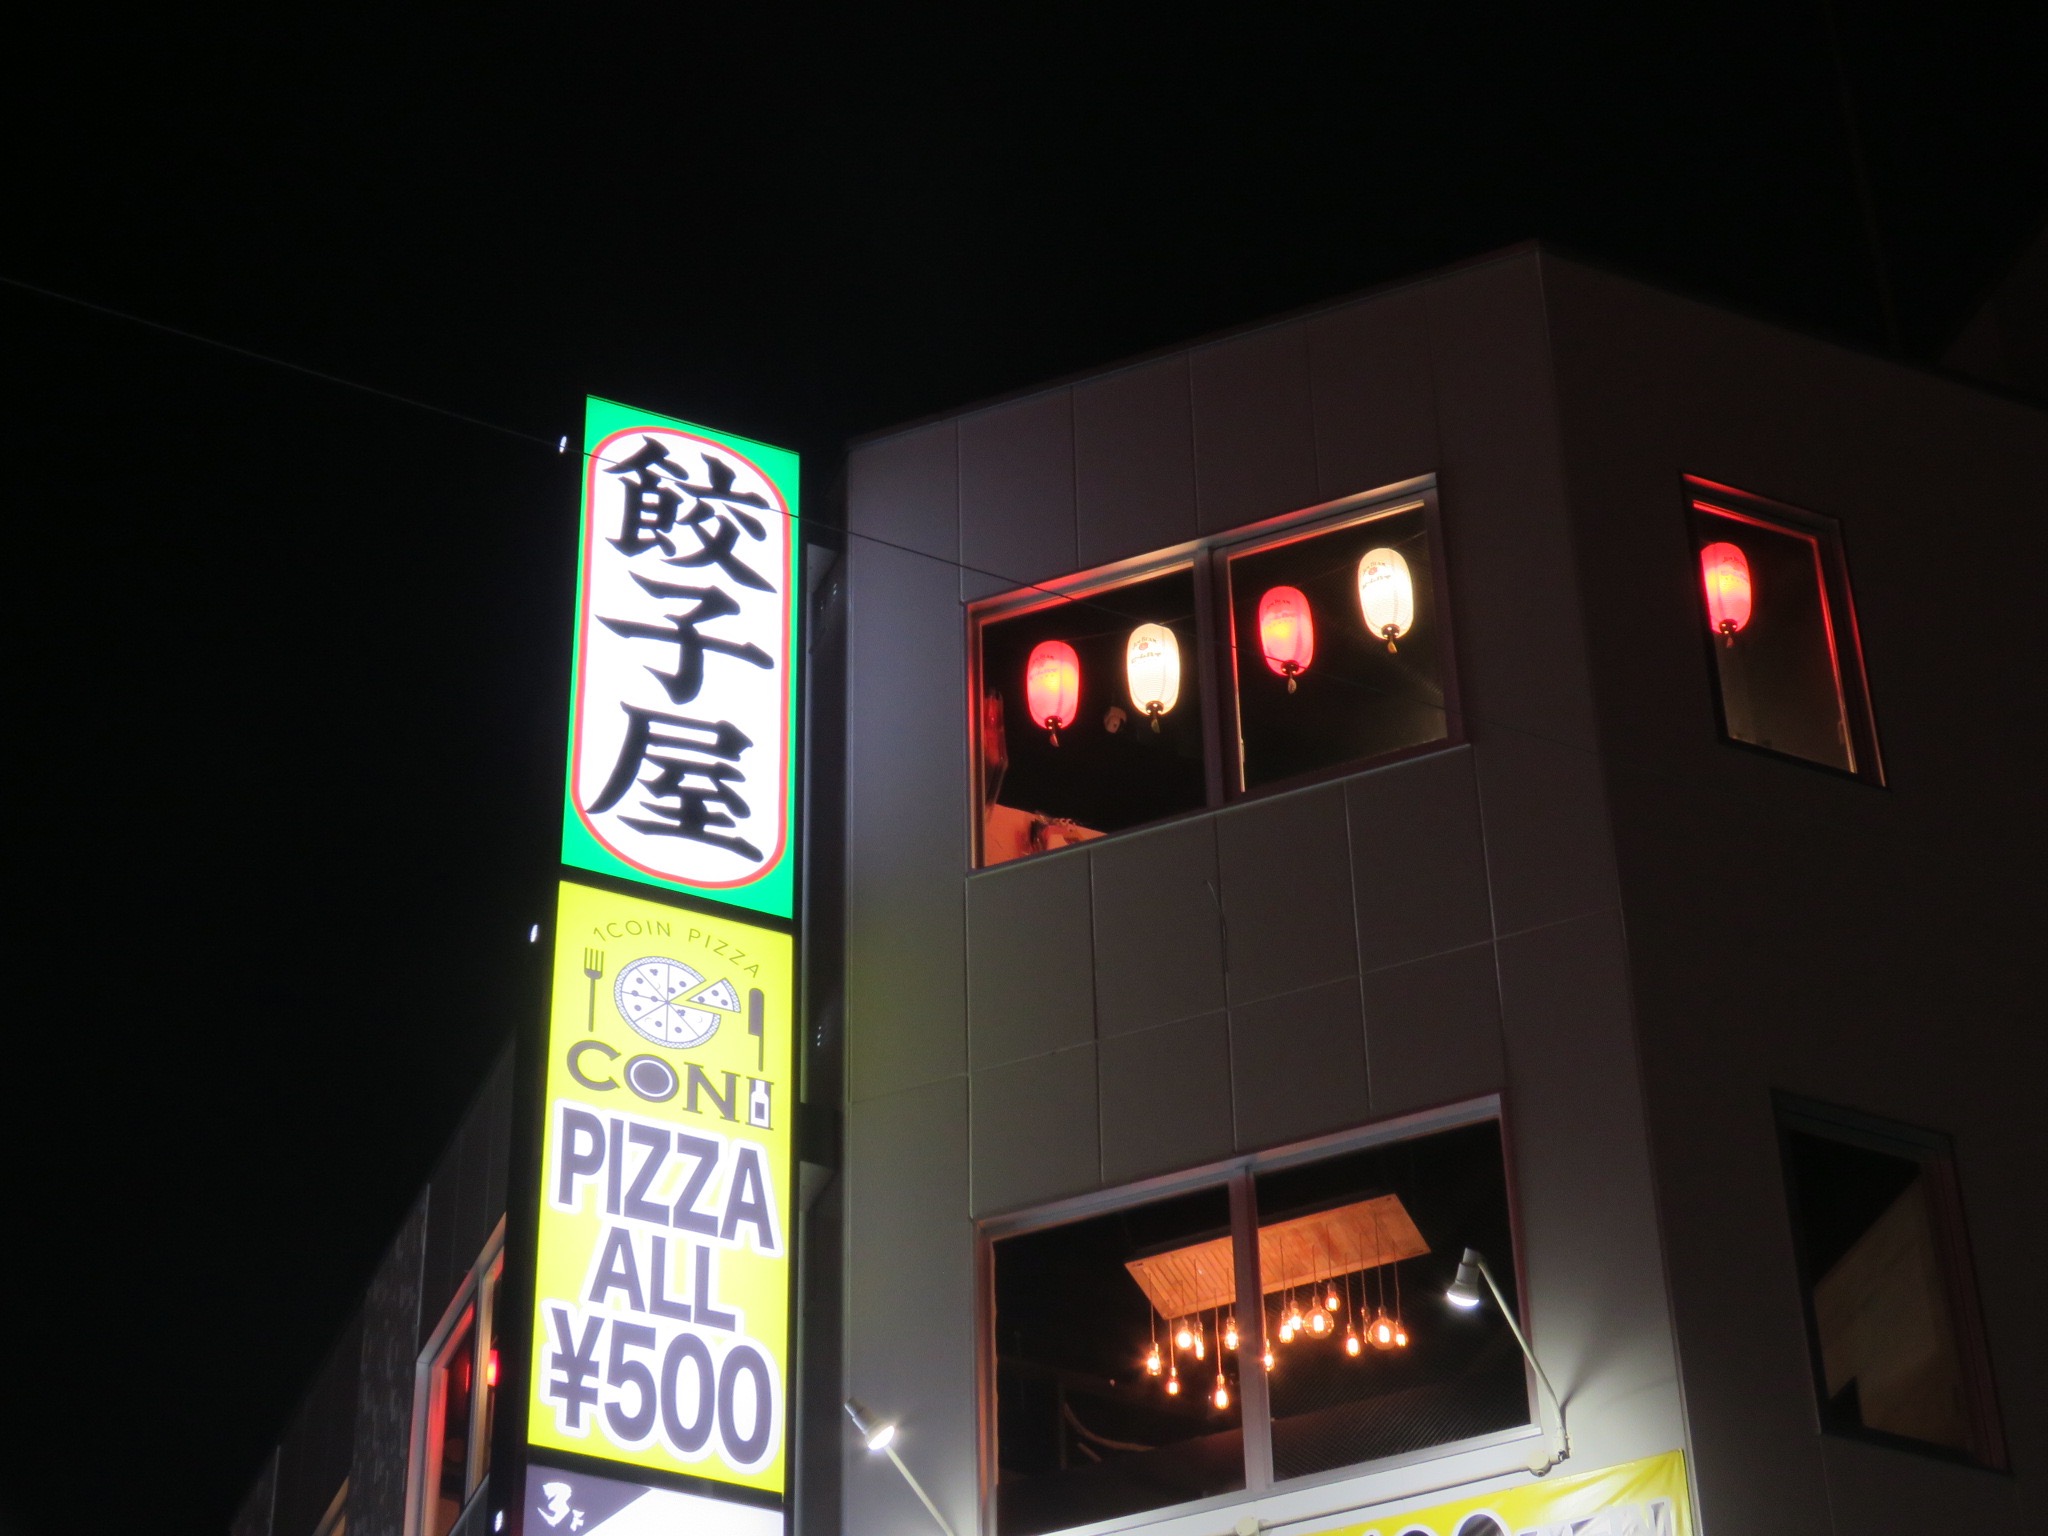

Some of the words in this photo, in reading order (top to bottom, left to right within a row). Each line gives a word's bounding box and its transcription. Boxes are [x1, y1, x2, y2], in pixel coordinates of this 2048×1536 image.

[585, 433, 778, 863] 餃子屋
[593, 919, 672, 942] 1COIN
[688, 928, 760, 979] PIZZA
[558, 1106, 775, 1250] PIZZA
[588, 1226, 736, 1332] ALL
[549, 1307, 773, 1465] ¥500
[536, 1481, 586, 1532] 3F
